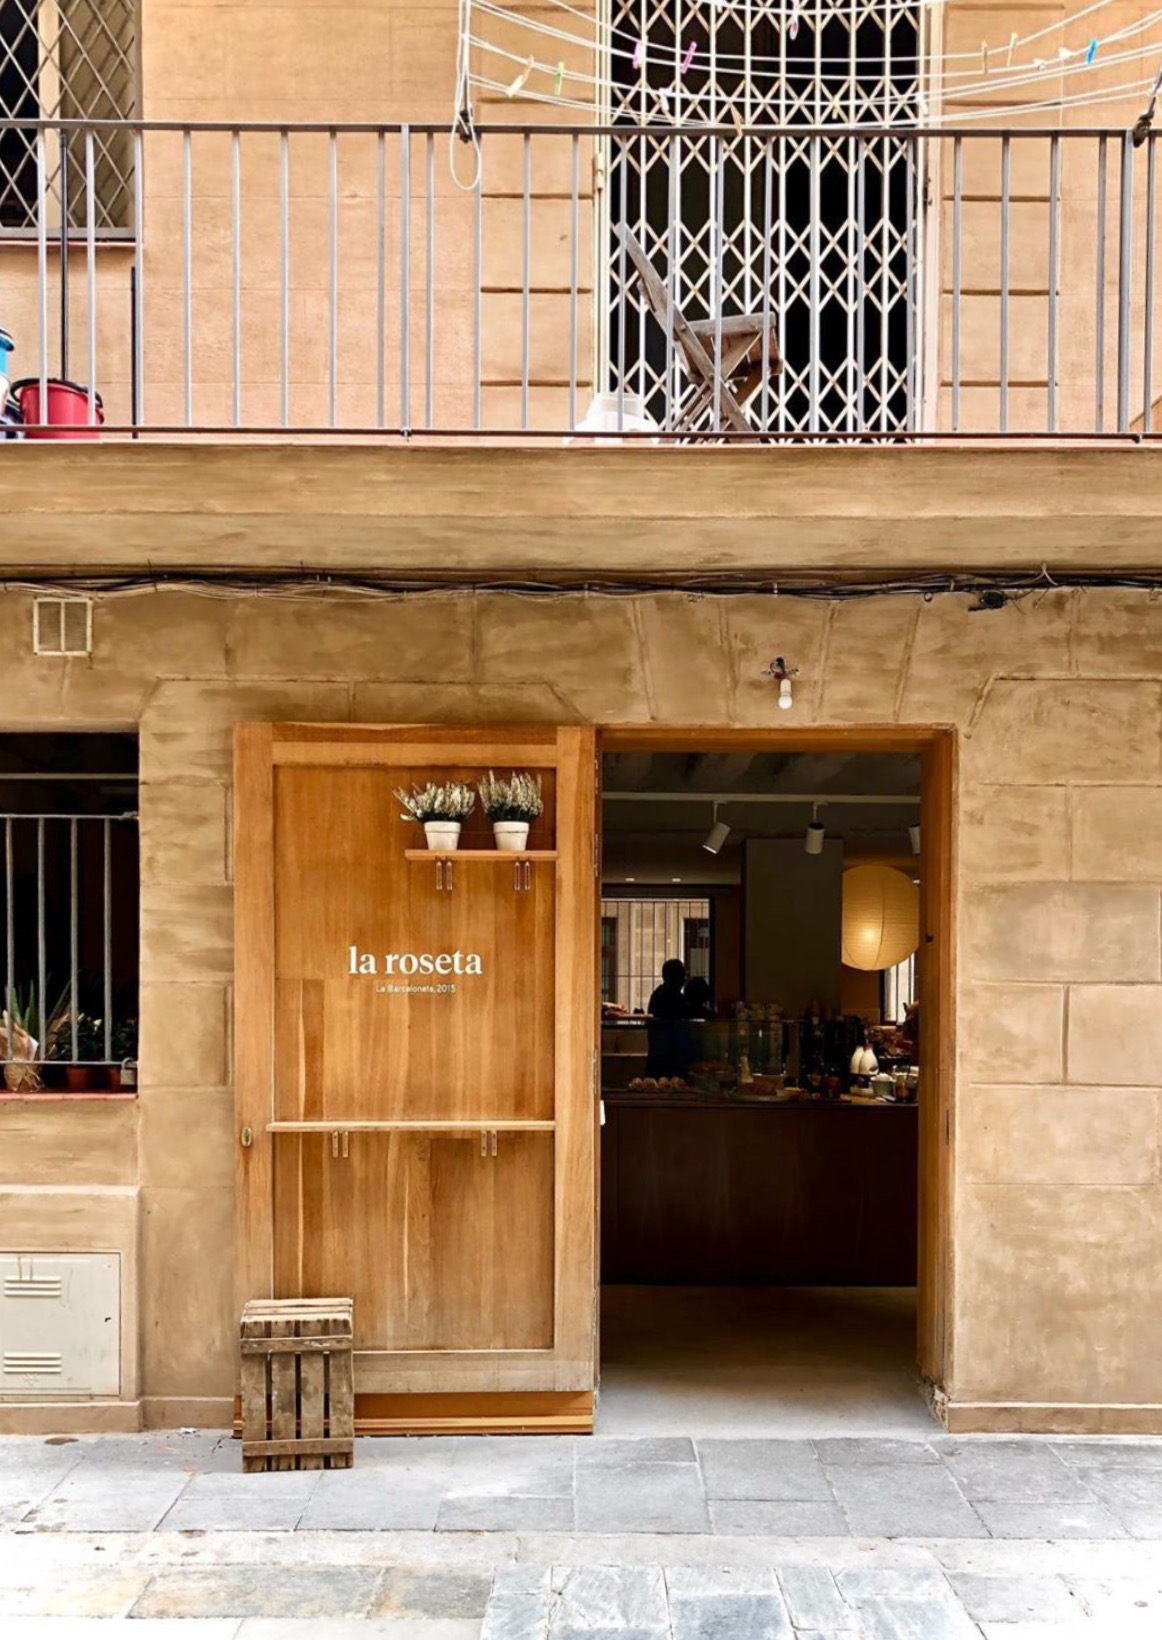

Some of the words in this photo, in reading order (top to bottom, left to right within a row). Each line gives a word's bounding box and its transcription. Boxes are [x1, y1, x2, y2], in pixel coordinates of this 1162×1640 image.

[349, 946, 377, 974] la
[385, 950, 483, 975] roseta
[376, 984, 386, 993] La
[437, 984, 456, 993] 2015
